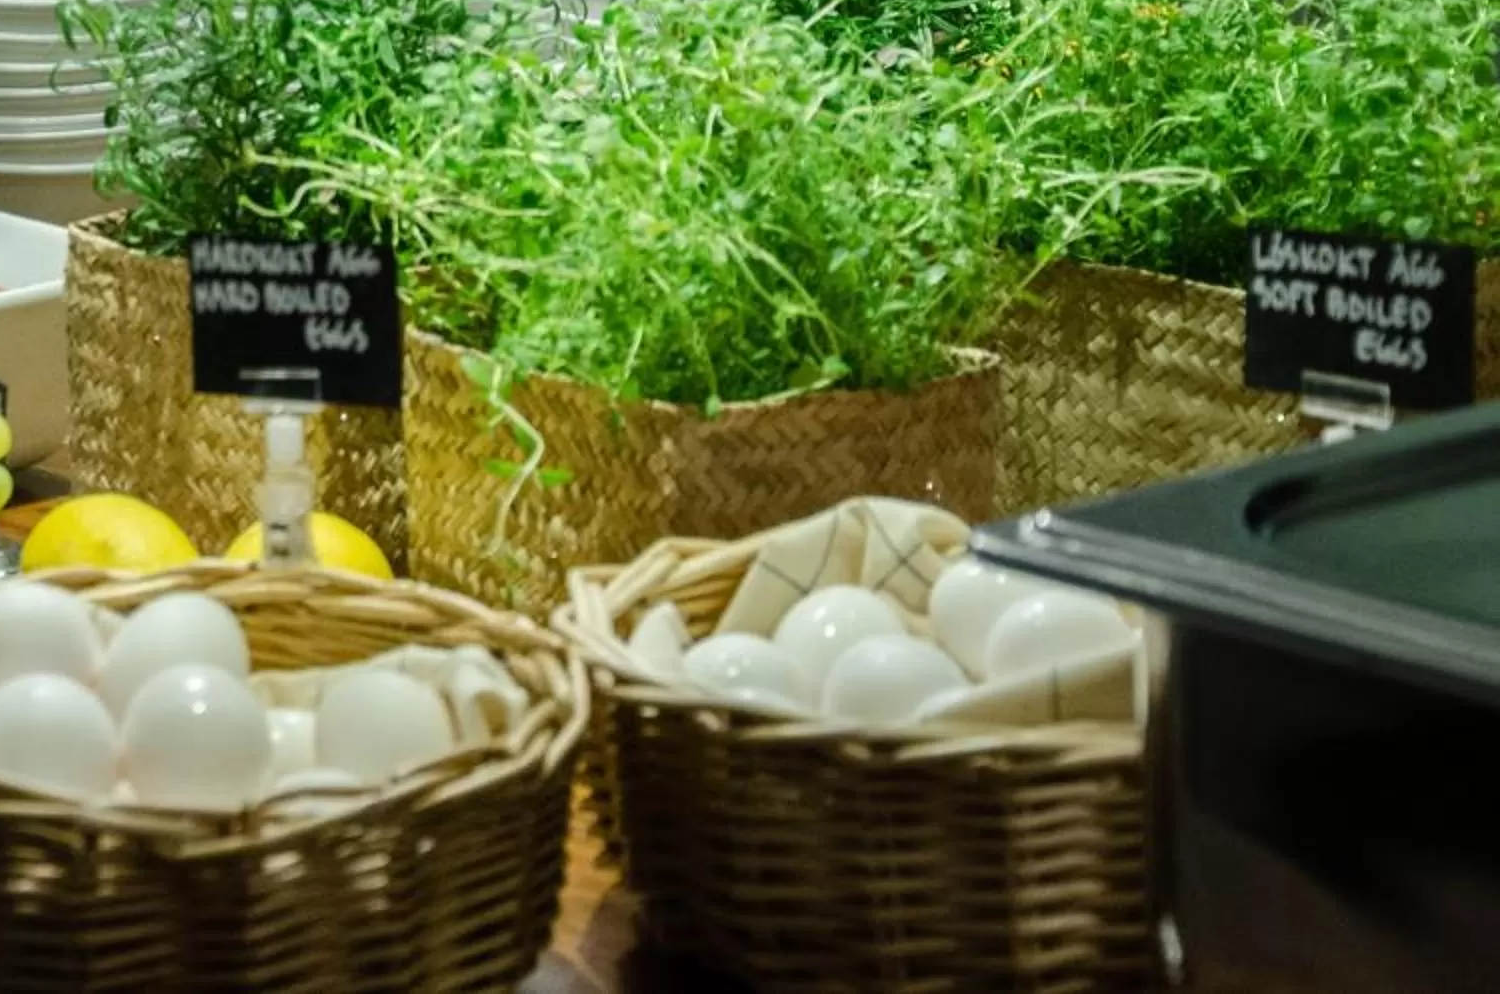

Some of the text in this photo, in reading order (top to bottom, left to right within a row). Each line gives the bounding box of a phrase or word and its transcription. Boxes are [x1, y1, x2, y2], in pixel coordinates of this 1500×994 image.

[194, 280, 350, 315] HARD BOILED
[1252, 276, 1432, 331] SOFT BOILED
[1355, 328, 1428, 372] EGGS
